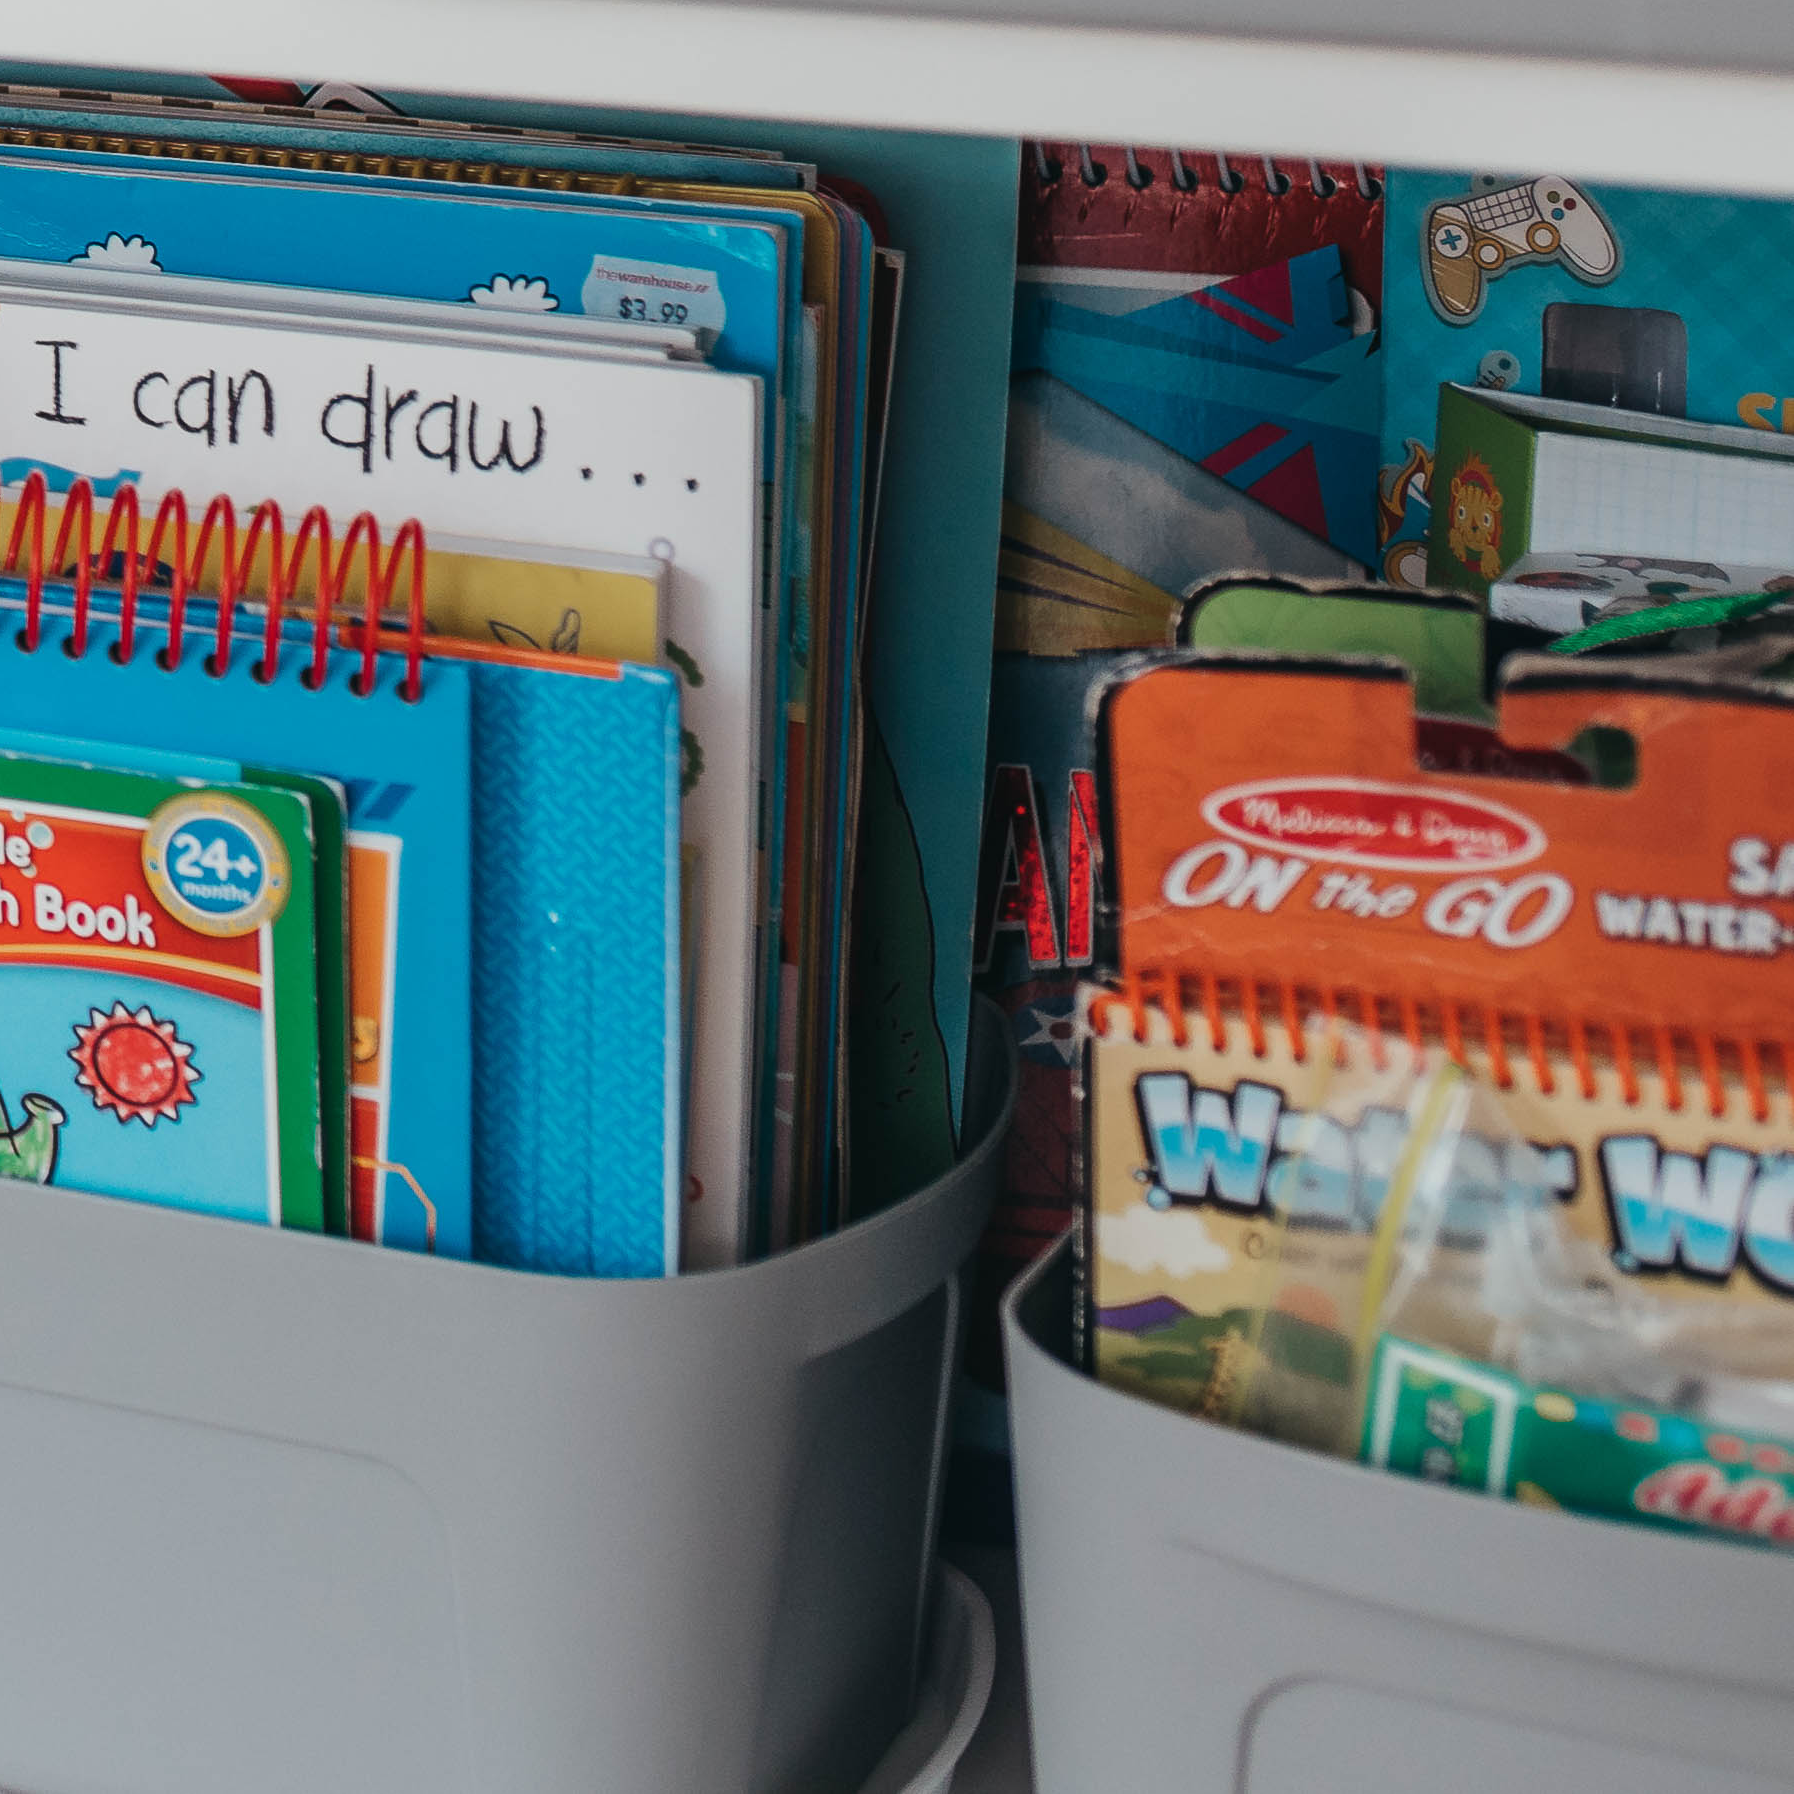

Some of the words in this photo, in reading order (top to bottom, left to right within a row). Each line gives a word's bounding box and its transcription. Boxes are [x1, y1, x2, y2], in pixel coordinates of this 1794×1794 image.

[33, 339, 86, 426] I
[132, 368, 276, 447] can
[172, 832, 258, 882] 24+
[1162, 840, 1312, 914] ON
[1314, 868, 1418, 919] the
[1421, 872, 1575, 950] GO
[33, 883, 157, 948] Book
